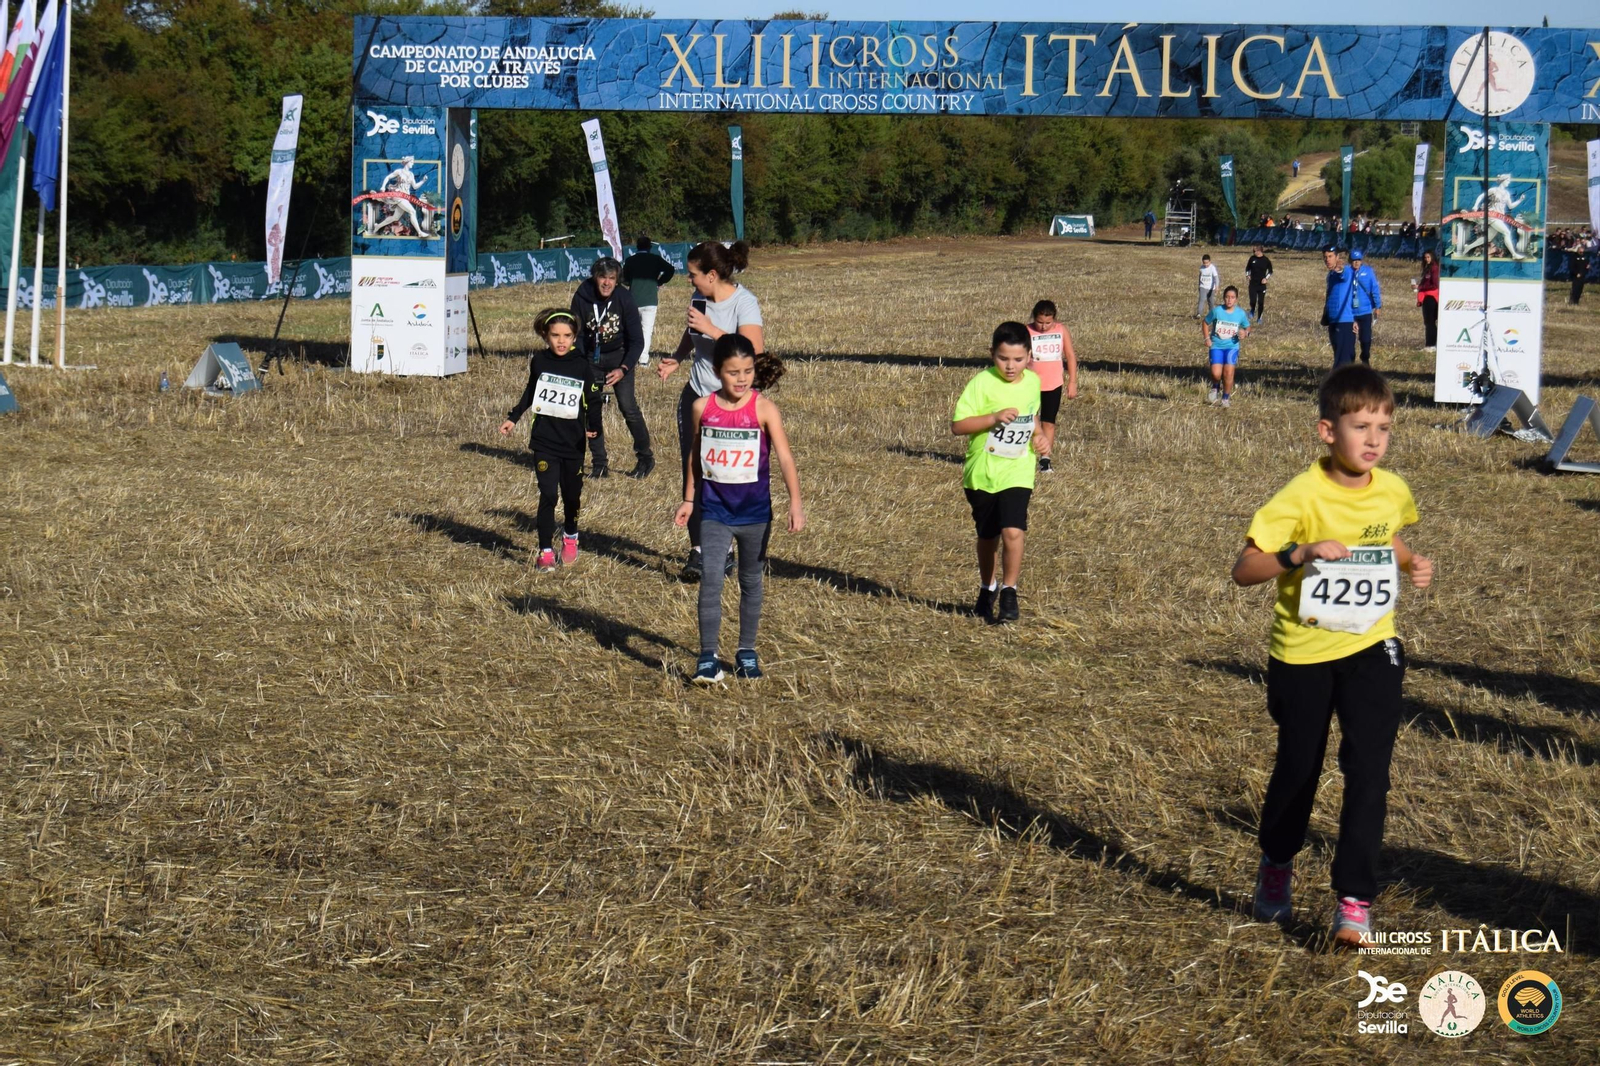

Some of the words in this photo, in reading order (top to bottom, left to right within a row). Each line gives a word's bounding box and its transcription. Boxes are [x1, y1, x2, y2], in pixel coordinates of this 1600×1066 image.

[370, 45, 478, 59] CAMPEONATO
[480, 46, 501, 60] DE
[503, 44, 596, 60] ANDALUCÍA
[829, 35, 959, 68] CROSS
[405, 61, 426, 73] DE
[428, 61, 485, 74] CAMPO
[487, 61, 500, 74] A
[502, 59, 562, 75] TRAVÉS
[659, 33, 826, 89] XLIII
[1020, 22, 1345, 100] ITÁLICA
[440, 75, 471, 88] POR
[473, 75, 529, 89] CLUBES
[829, 72, 1008, 90] INTERNACIONAL
[659, 92, 815, 110] INTERNATIONAL
[818, 93, 878, 111] CROSS
[882, 93, 975, 111] COUNTRY
[402, 117, 436, 126] Diputación
[402, 125, 436, 135] Sevilla
[1498, 133, 1536, 141] Diputación
[1498, 141, 1536, 152] Sevilla
[106, 290, 134, 306] Sevilla
[1035, 343, 1061, 354] 4503
[538, 388, 578, 408] 4218
[993, 427, 1032, 446] 4323
[705, 448, 755, 468] 4472
[1310, 577, 1391, 607] 4295
